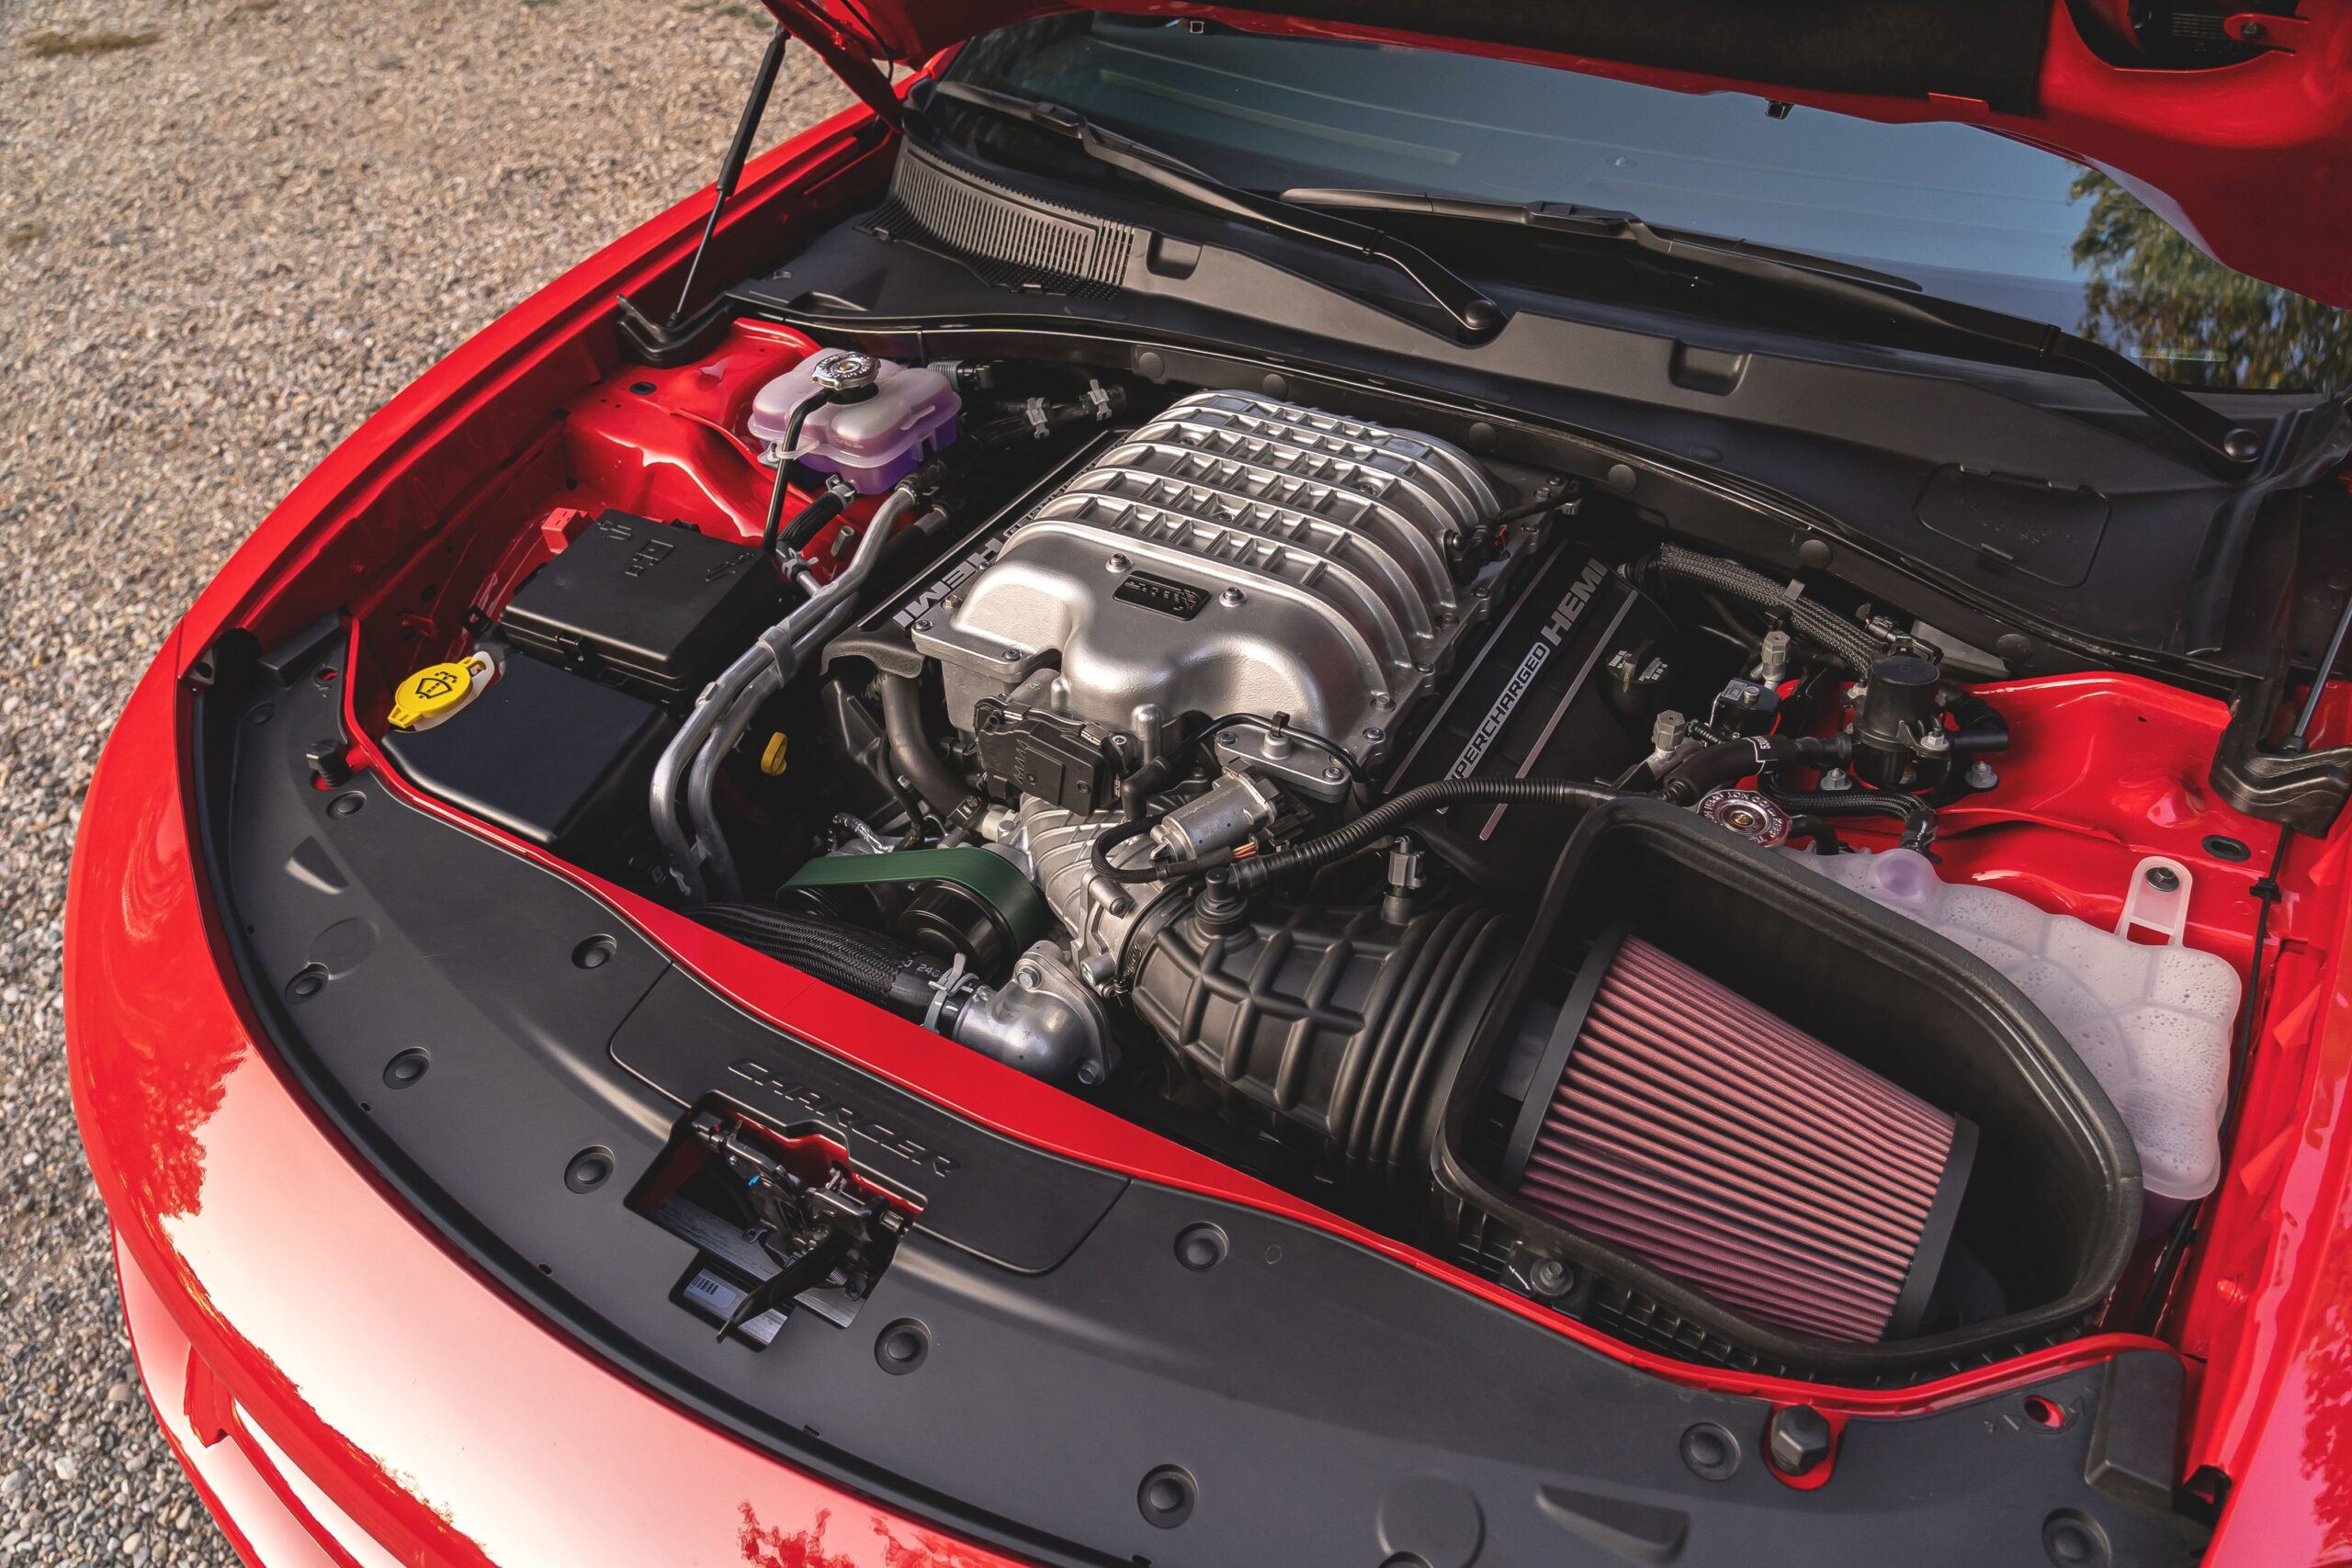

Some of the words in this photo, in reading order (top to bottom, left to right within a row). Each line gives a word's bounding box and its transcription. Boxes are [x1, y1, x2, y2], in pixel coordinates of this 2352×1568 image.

[892, 537, 1004, 628] HEMI
[1449, 643, 1548, 780] PERCHARGED
[1541, 558, 1608, 646] HEMI
[727, 1059, 962, 1178] CHARGER
